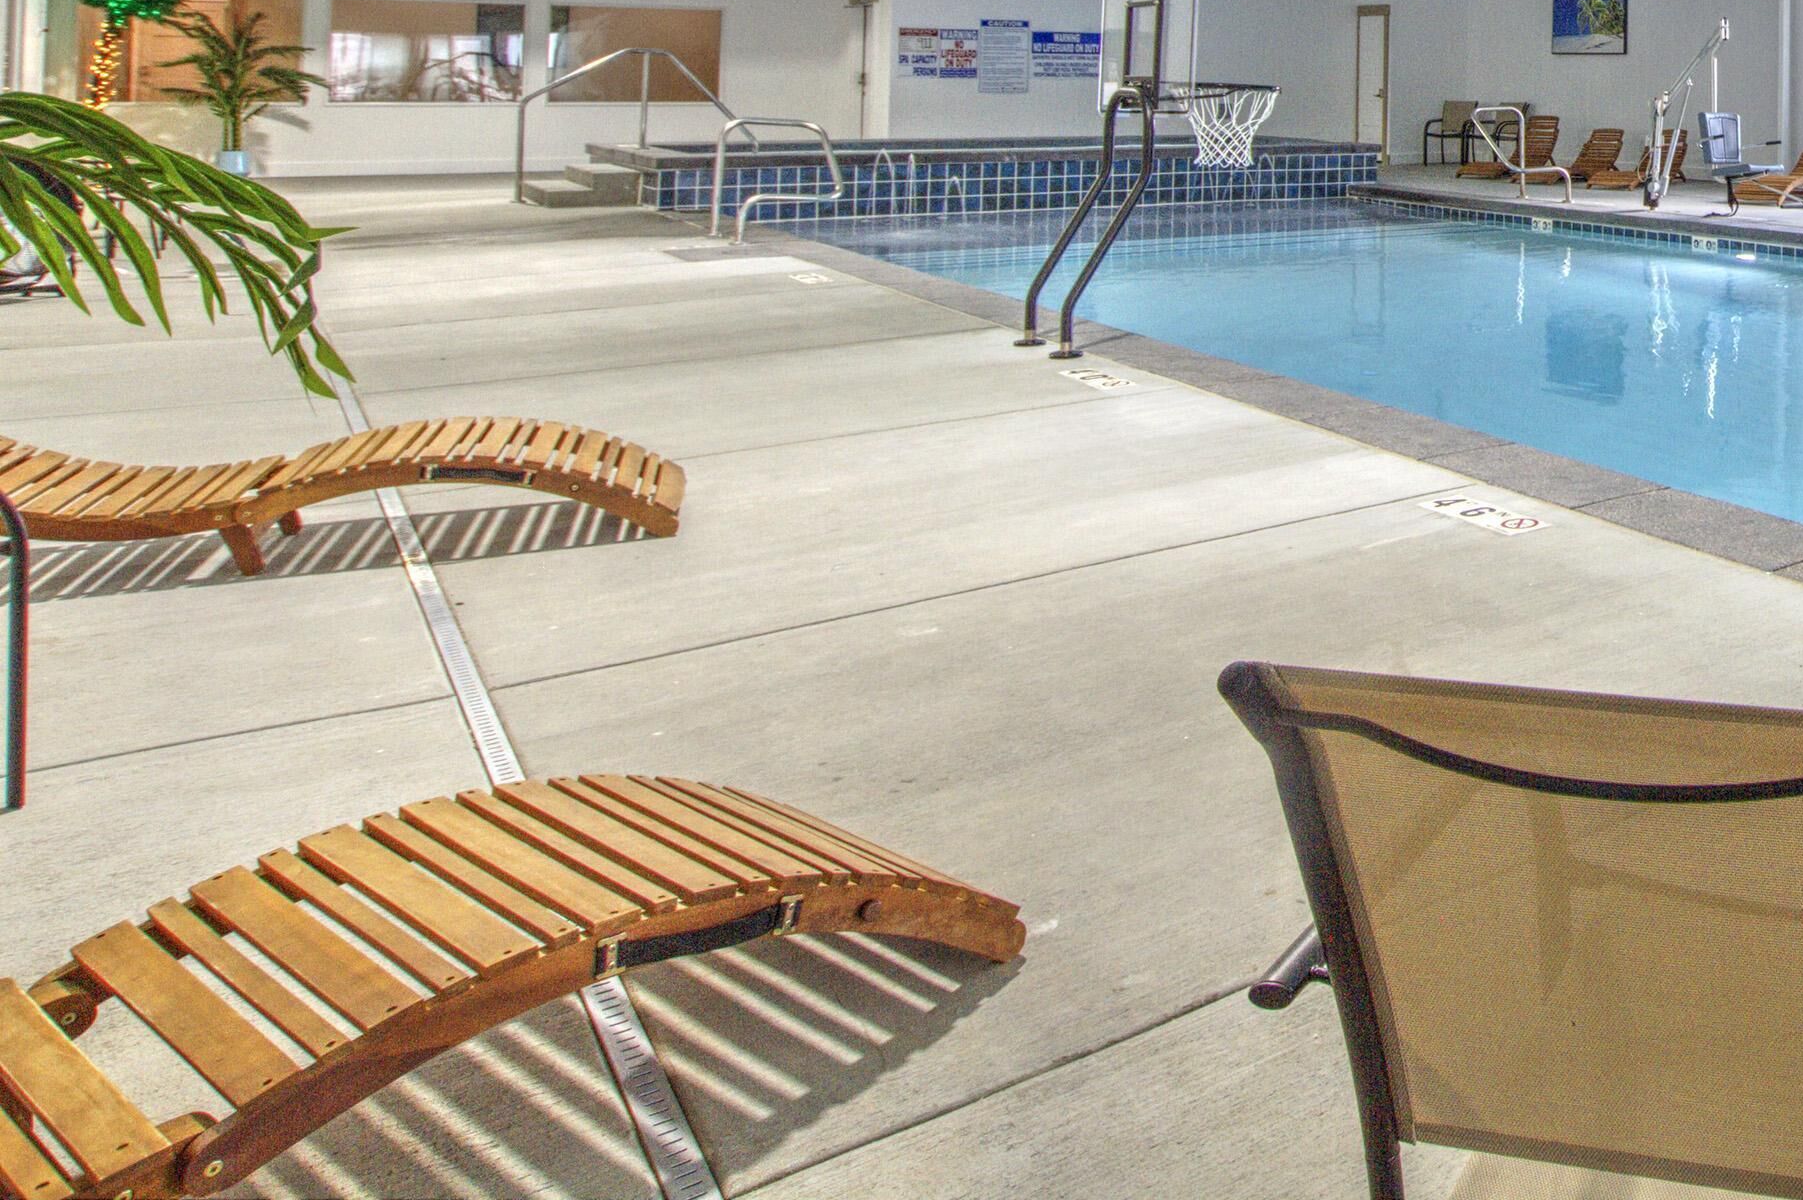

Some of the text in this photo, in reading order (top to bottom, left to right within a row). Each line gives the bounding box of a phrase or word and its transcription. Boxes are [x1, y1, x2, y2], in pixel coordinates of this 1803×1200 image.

[941, 30, 978, 39] WARNING
[955, 40, 964, 48] NO
[1033, 43, 1099, 53] NO LIFEGUARD ON DUTY
[941, 49, 977, 58] LIFEGUARD
[945, 59, 972, 67] ON DUTY
